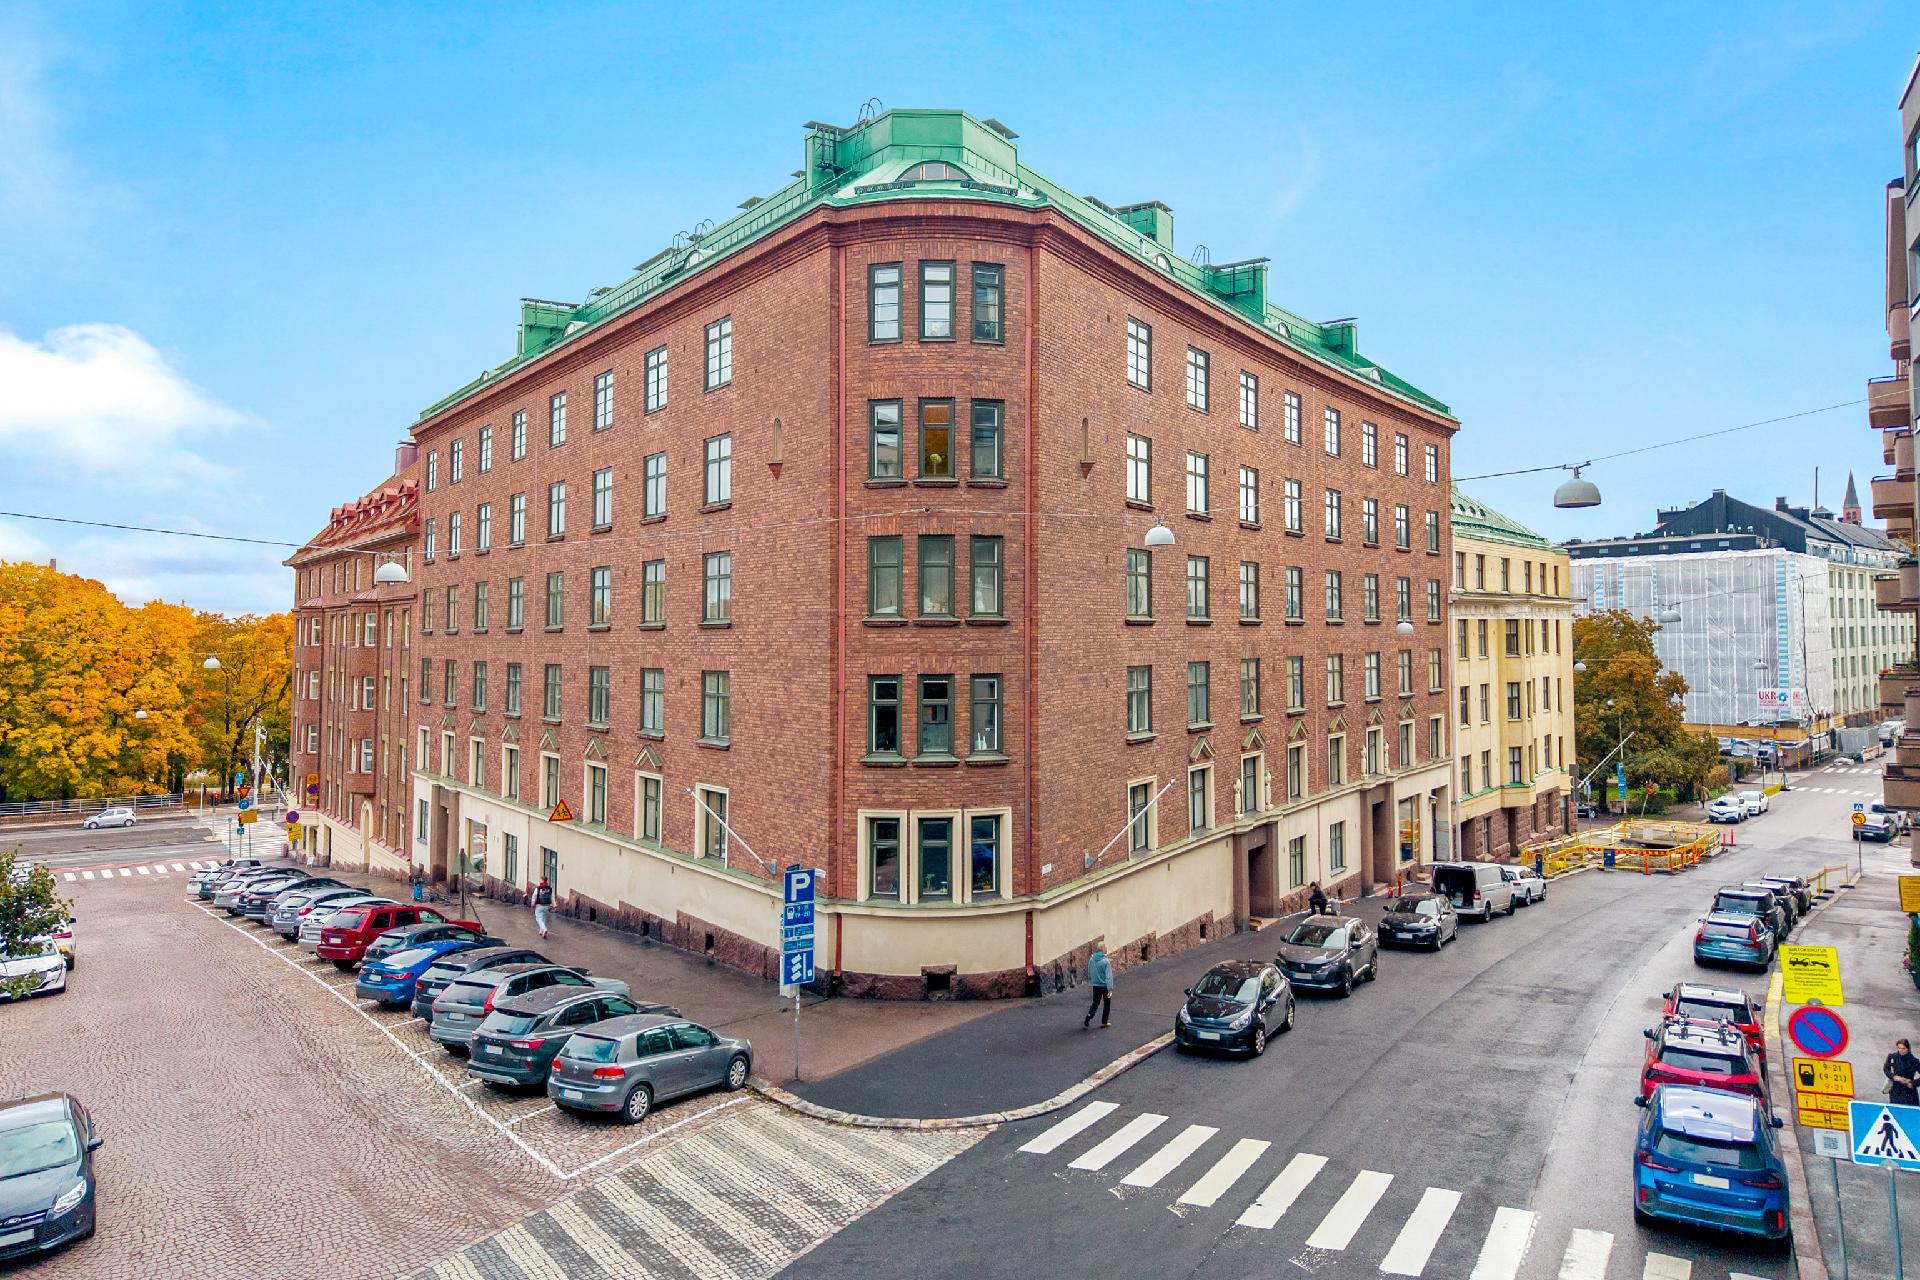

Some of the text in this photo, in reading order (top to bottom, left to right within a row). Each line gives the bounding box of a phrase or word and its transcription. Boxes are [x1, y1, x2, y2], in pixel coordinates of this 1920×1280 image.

[1758, 691, 1776, 700] UKR
[791, 873, 810, 901] P
[1819, 1072, 1847, 1083] (9-21)
[1823, 1113, 1833, 1125] H
